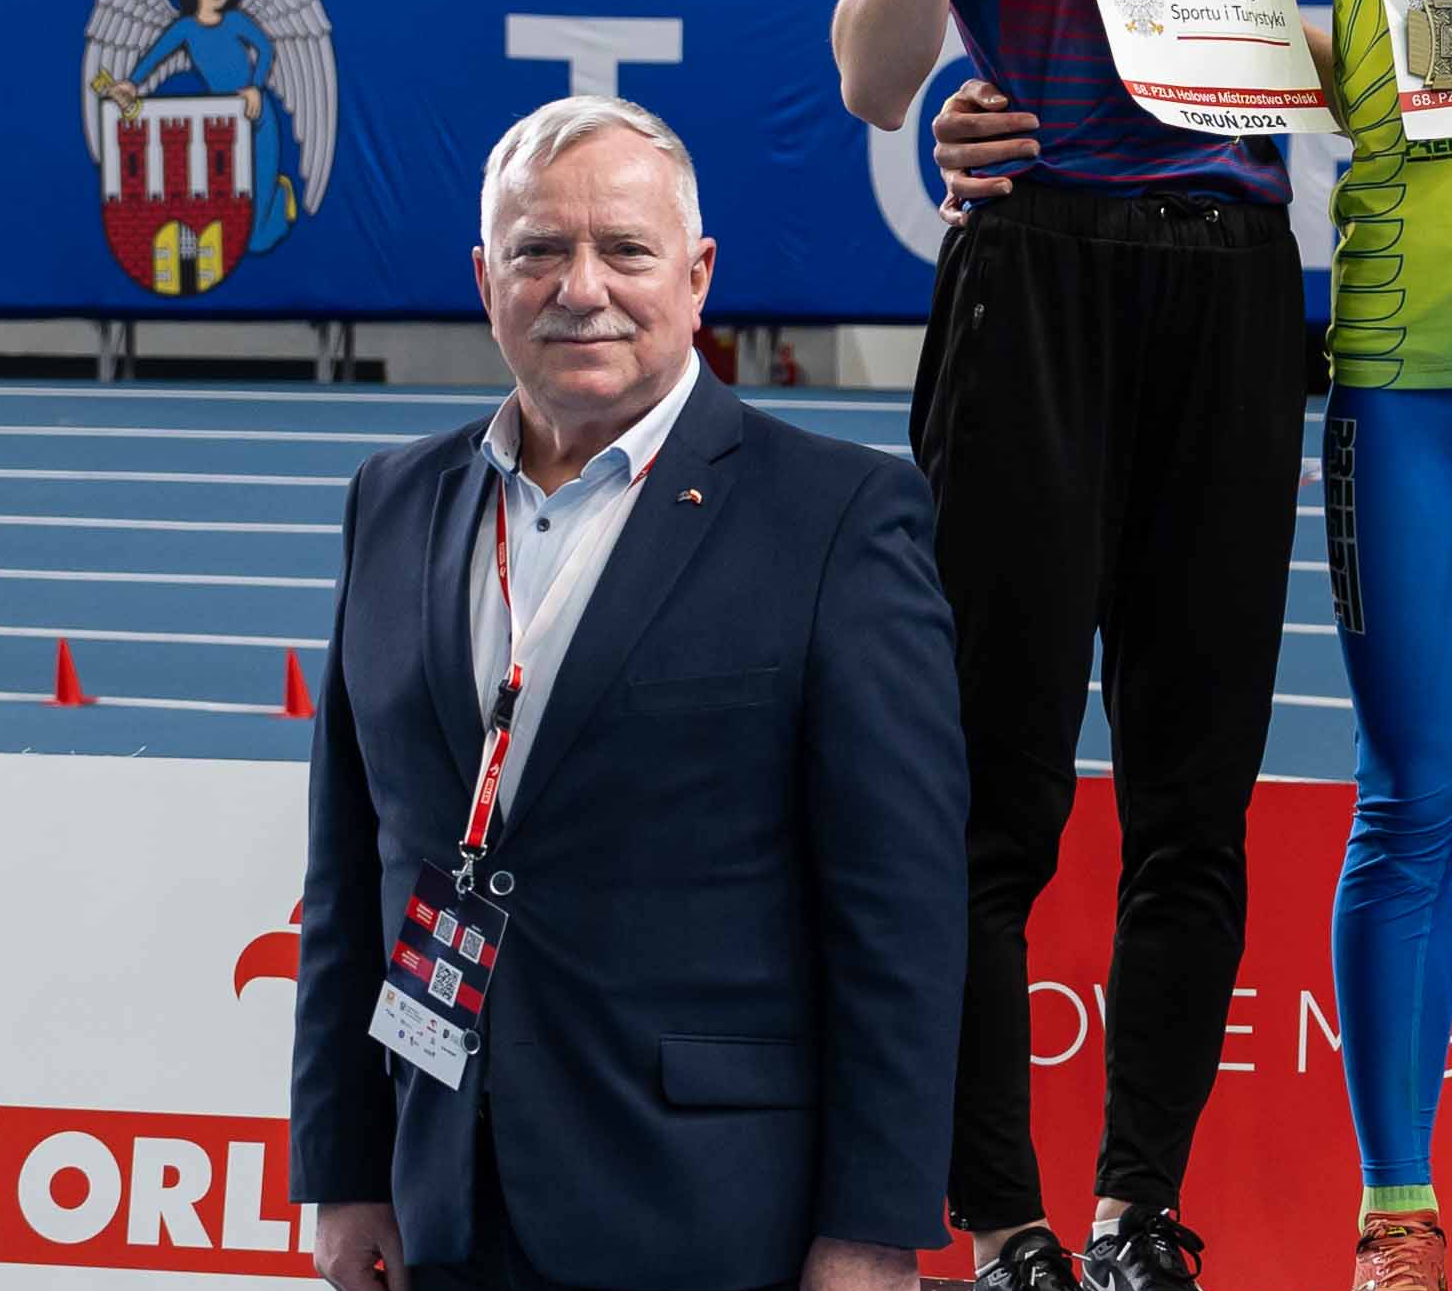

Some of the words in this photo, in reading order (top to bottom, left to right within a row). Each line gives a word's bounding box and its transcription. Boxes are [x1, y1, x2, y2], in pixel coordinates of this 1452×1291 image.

[1171, 4, 1221, 22] Sportu
[1233, 5, 1286, 29] Turystyki
[1133, 84, 1151, 97] 68.
[1152, 86, 1175, 101] PZLA
[1178, 90, 1216, 103] Halowe
[1218, 92, 1283, 105] Mistrzostwa
[1285, 93, 1318, 105] Polski
[1411, 91, 1436, 107] 68.
[1180, 110, 1238, 128] TORUŃ
[1241, 114, 1287, 128] 2024
[17, 1130, 313, 1255] ORL
